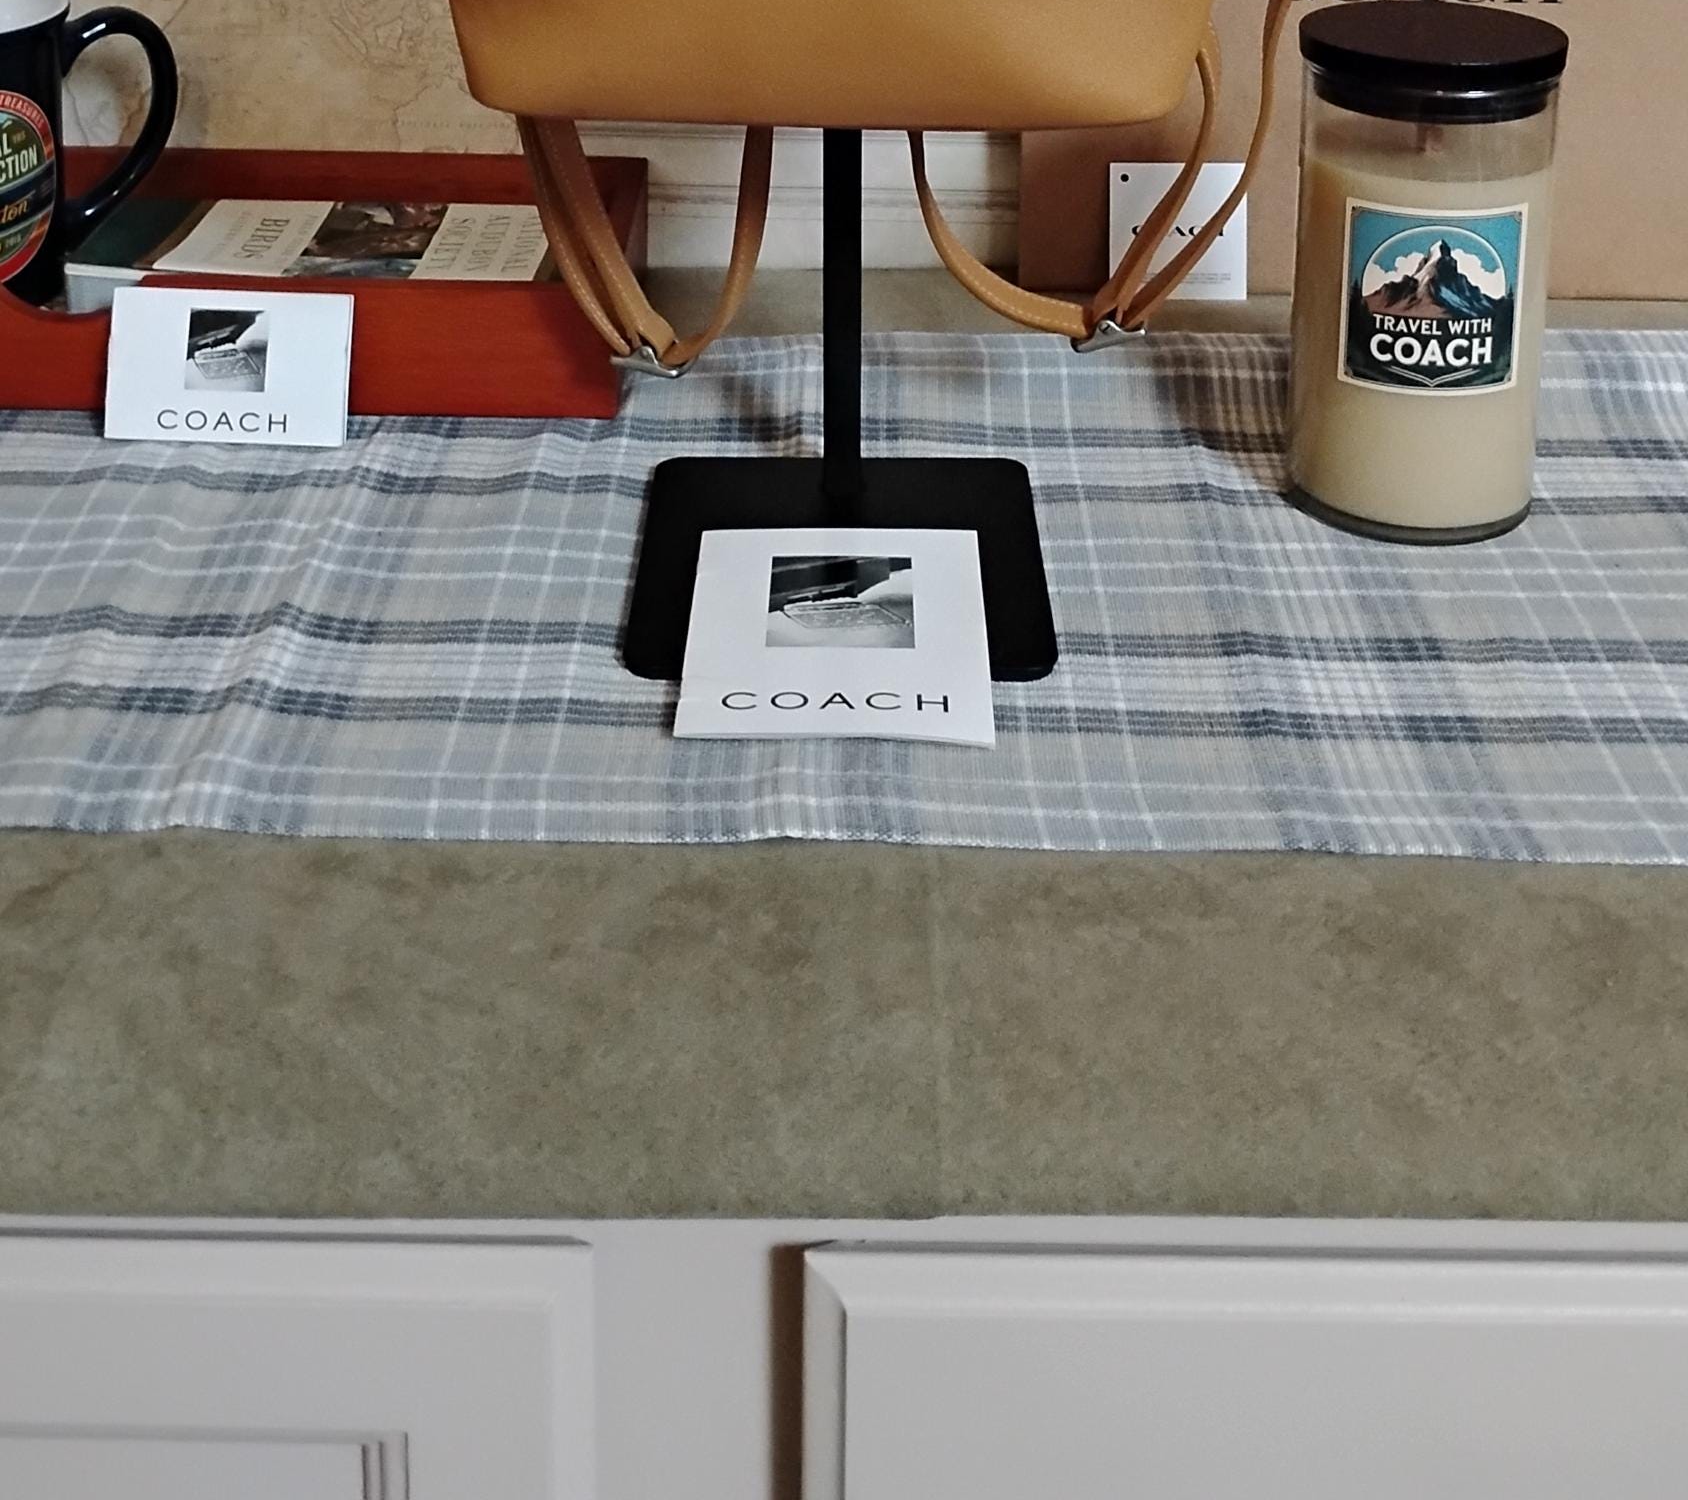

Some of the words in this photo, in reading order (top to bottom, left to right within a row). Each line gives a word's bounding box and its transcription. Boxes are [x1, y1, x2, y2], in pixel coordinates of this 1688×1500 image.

[233, 217, 290, 259] BIRDS
[1372, 313, 1442, 335] TRAVEL
[1448, 317, 1492, 335] WITH
[1369, 333, 1493, 367] COACH
[157, 408, 287, 433] COACH
[721, 690, 950, 713] COACH
